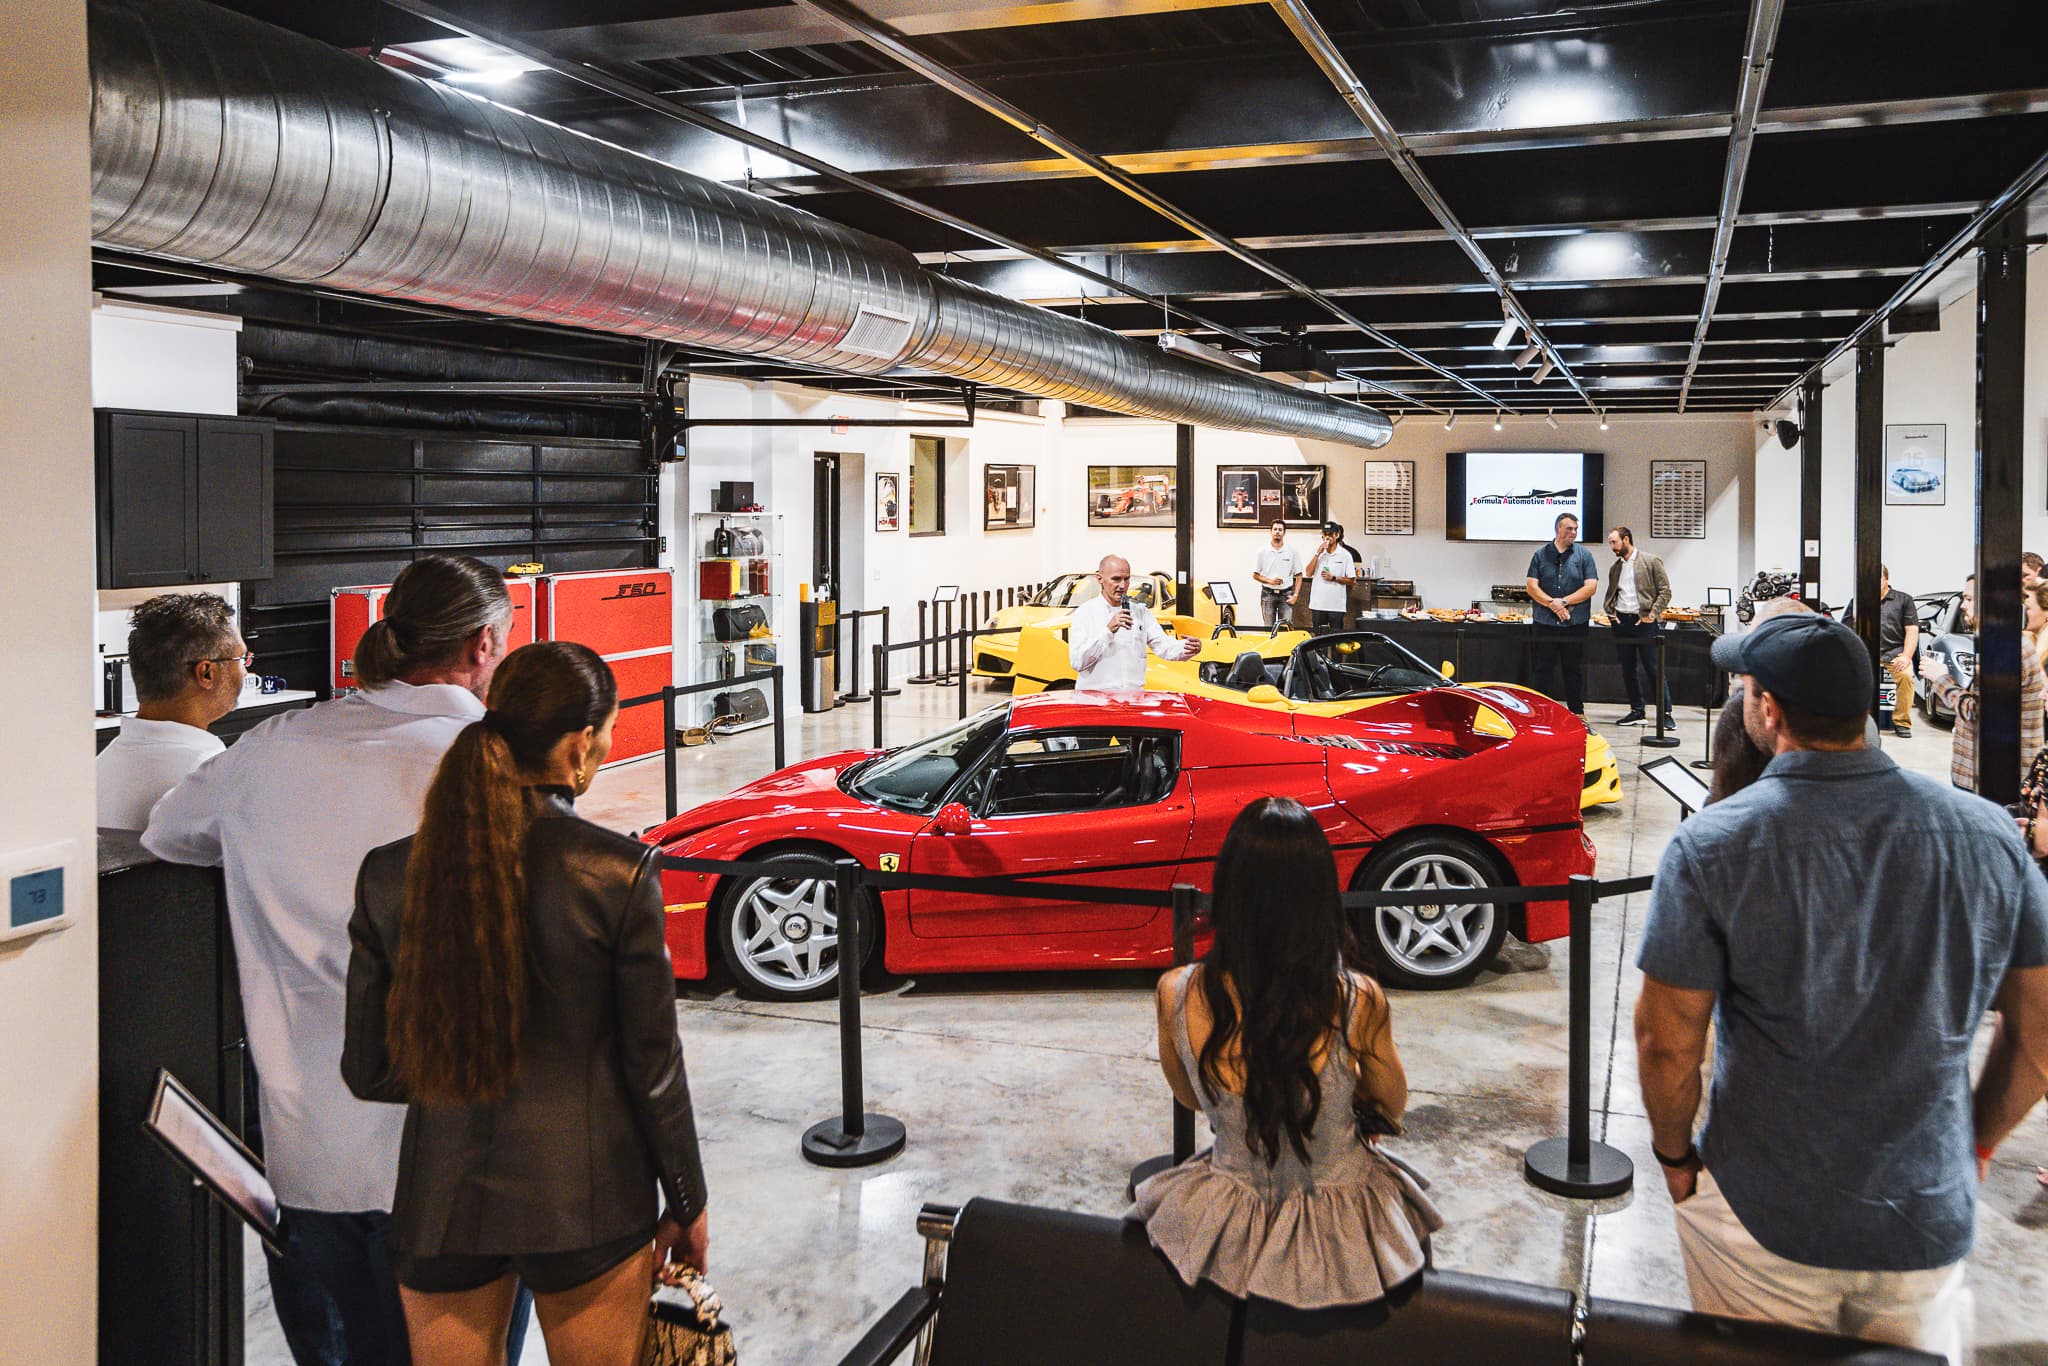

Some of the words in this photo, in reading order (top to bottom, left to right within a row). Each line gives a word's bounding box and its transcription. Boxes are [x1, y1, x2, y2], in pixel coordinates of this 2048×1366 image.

[1473, 497, 1502, 505] Formula
[1503, 497, 1545, 505] Automotive
[617, 582, 657, 598] F50
